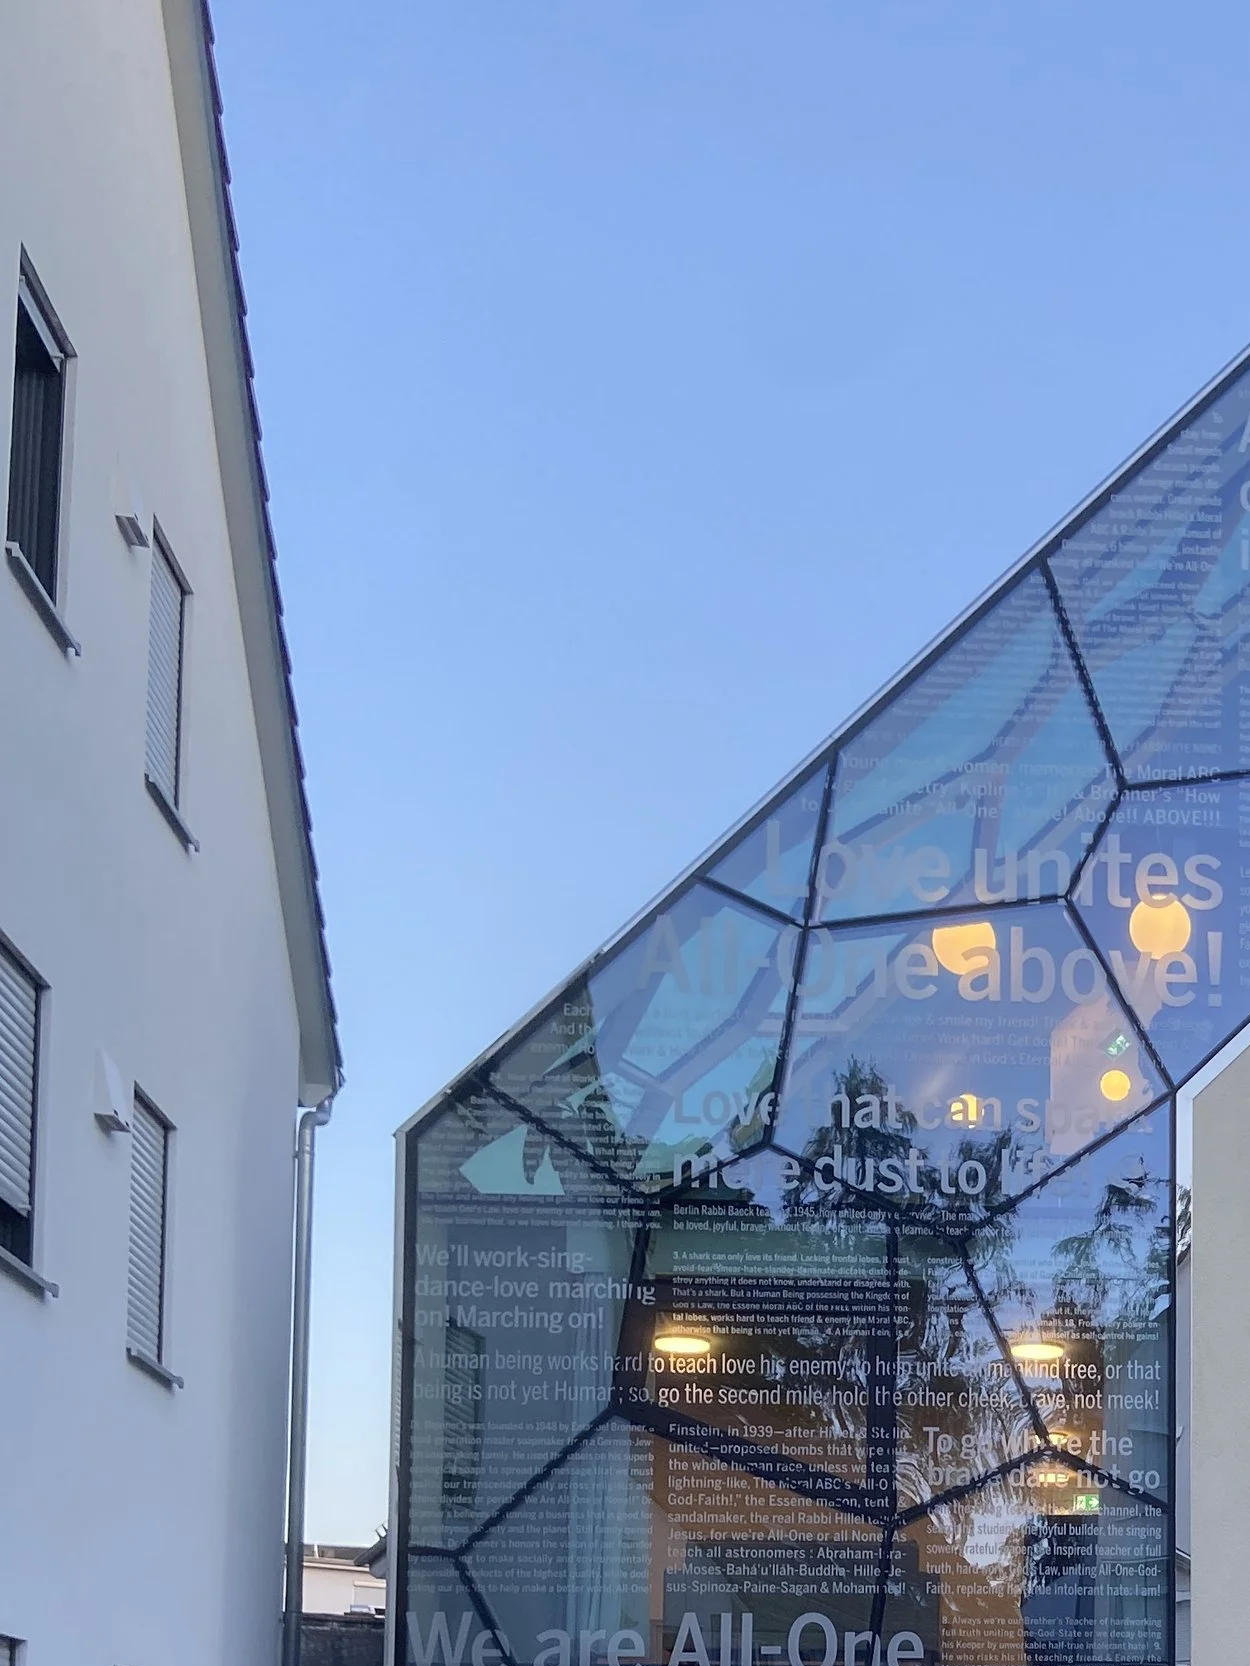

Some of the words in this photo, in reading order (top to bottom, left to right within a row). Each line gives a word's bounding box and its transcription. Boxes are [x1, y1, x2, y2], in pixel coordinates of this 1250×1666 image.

[765, 820, 950, 904] Love
[974, 833, 1224, 910] unites
[637, 915, 938, 1002] All-One
[958, 926, 1224, 1007] above!
[674, 1091, 782, 1125] Love
[808, 1083, 903, 1130] hat
[918, 1095, 1001, 1130] can
[814, 1144, 924, 1193] dust
[938, 1153, 987, 1195] to
[674, 1204, 699, 1215] Berlin
[702, 1205, 725, 1216] Rabbi
[728, 1206, 753, 1217] Baeck
[416, 1244, 468, 1267] We'll
[474, 1246, 593, 1273] work-sing-
[415, 1275, 539, 1297] dance-love
[753, 1290, 780, 1298] Human
[807, 1291, 849, 1300] possessing
[415, 1305, 449, 1327] on!
[457, 1305, 563, 1333] Marching
[568, 1308, 603, 1329] on!
[711, 1314, 734, 1322] works
[737, 1314, 754, 1322] hard
[767, 1314, 788, 1323] teach
[430, 1352, 489, 1369] human
[496, 1351, 543, 1375] being
[549, 1353, 599, 1371] works
[603, 1351, 642, 1371] hard
[648, 1354, 664, 1372] to
[668, 1354, 717, 1373] teach
[722, 1354, 755, 1374] love
[1065, 1361, 1101, 1381] free,
[1105, 1363, 1122, 1379] or
[1127, 1360, 1161, 1380] that
[414, 1382, 461, 1404] being
[468, 1382, 481, 1400] is
[488, 1381, 516, 1400] not
[521, 1381, 548, 1405] yet
[659, 1389, 679, 1407] go
[685, 1383, 713, 1404] the
[719, 1384, 780, 1405] second
[832, 1386, 869, 1405] hold
[875, 1385, 902, 1406] the
[909, 1389, 953, 1407] other
[959, 1390, 1013, 1409] cheek,
[1075, 1393, 1102, 1409] not
[1108, 1390, 1159, 1410] meek!
[923, 1427, 950, 1453] To
[1090, 1430, 1132, 1456] the
[782, 1443, 823, 1455] bombs
[828, 1444, 852, 1456] that
[669, 1459, 688, 1471] the
[692, 1459, 728, 1471] whole
[776, 1462, 806, 1473] race,
[809, 1462, 847, 1473] unless
[668, 1476, 750, 1490] lightning-like,
[753, 1477, 775, 1489] The
[1078, 1465, 1120, 1489] not
[1130, 1469, 1160, 1493] go
[745, 1494, 764, 1506] the
[769, 1495, 812, 1507] Essene
[668, 1511, 748, 1524] sandalmaker,
[772, 1512, 794, 1524] real
[798, 1512, 832, 1524] Rabbi
[835, 1512, 865, 1524] Hillel
[1099, 1506, 1142, 1518] channel,
[1145, 1505, 1161, 1517] the
[668, 1528, 706, 1542] Jesus,
[732, 1529, 764, 1541] we're
[768, 1529, 813, 1541] All-One
[833, 1530, 847, 1542] all
[1039, 1523, 1066, 1539] joyful
[1069, 1524, 1104, 1537] builder,
[1126, 1525, 1161, 1539] singing
[725, 1546, 805, 1559] astronomers
[1053, 1544, 1092, 1559] Inspired
[1095, 1544, 1131, 1557] teacher
[1039, 1564, 1061, 1577] Law,
[1063, 1564, 1097, 1579] uniting
[1099, 1563, 1161, 1577] All-One-God-
[820, 1582, 829, 1593] &
[926, 1581, 954, 1595] Faith,
[957, 1582, 1003, 1598] replacing
[1054, 1583, 1103, 1596] intolerant
[952, 1617, 981, 1626] Always
[1025, 1617, 1063, 1626] Brother's
[1065, 1617, 1097, 1626] Teacher
[1035, 1653, 1073, 1664] teaching
[1115, 1654, 1144, 1664] Enemy
